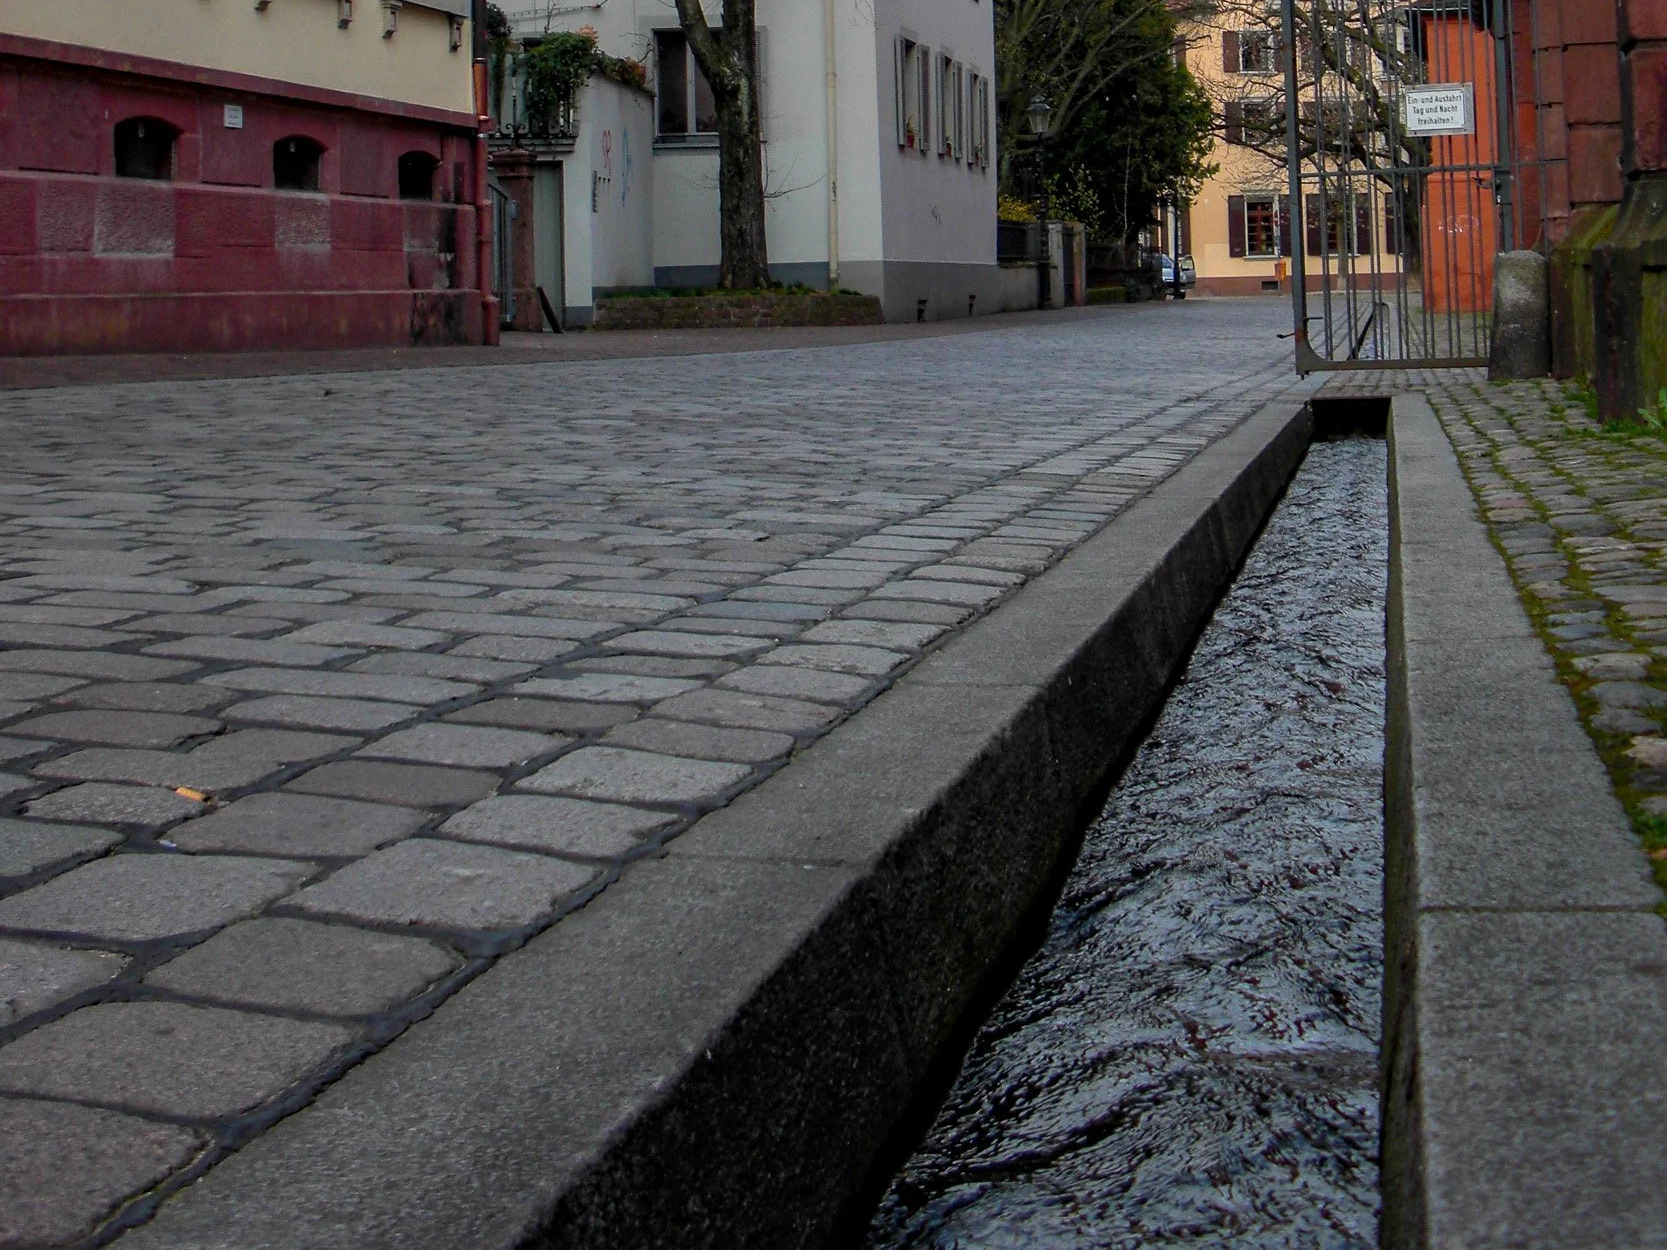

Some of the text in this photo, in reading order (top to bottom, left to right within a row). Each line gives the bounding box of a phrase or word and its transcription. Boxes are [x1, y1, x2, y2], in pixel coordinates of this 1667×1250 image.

[1408, 94, 1462, 104] Ein- und Ausfahrt
[1413, 105, 1458, 115] Tag und Nacht
